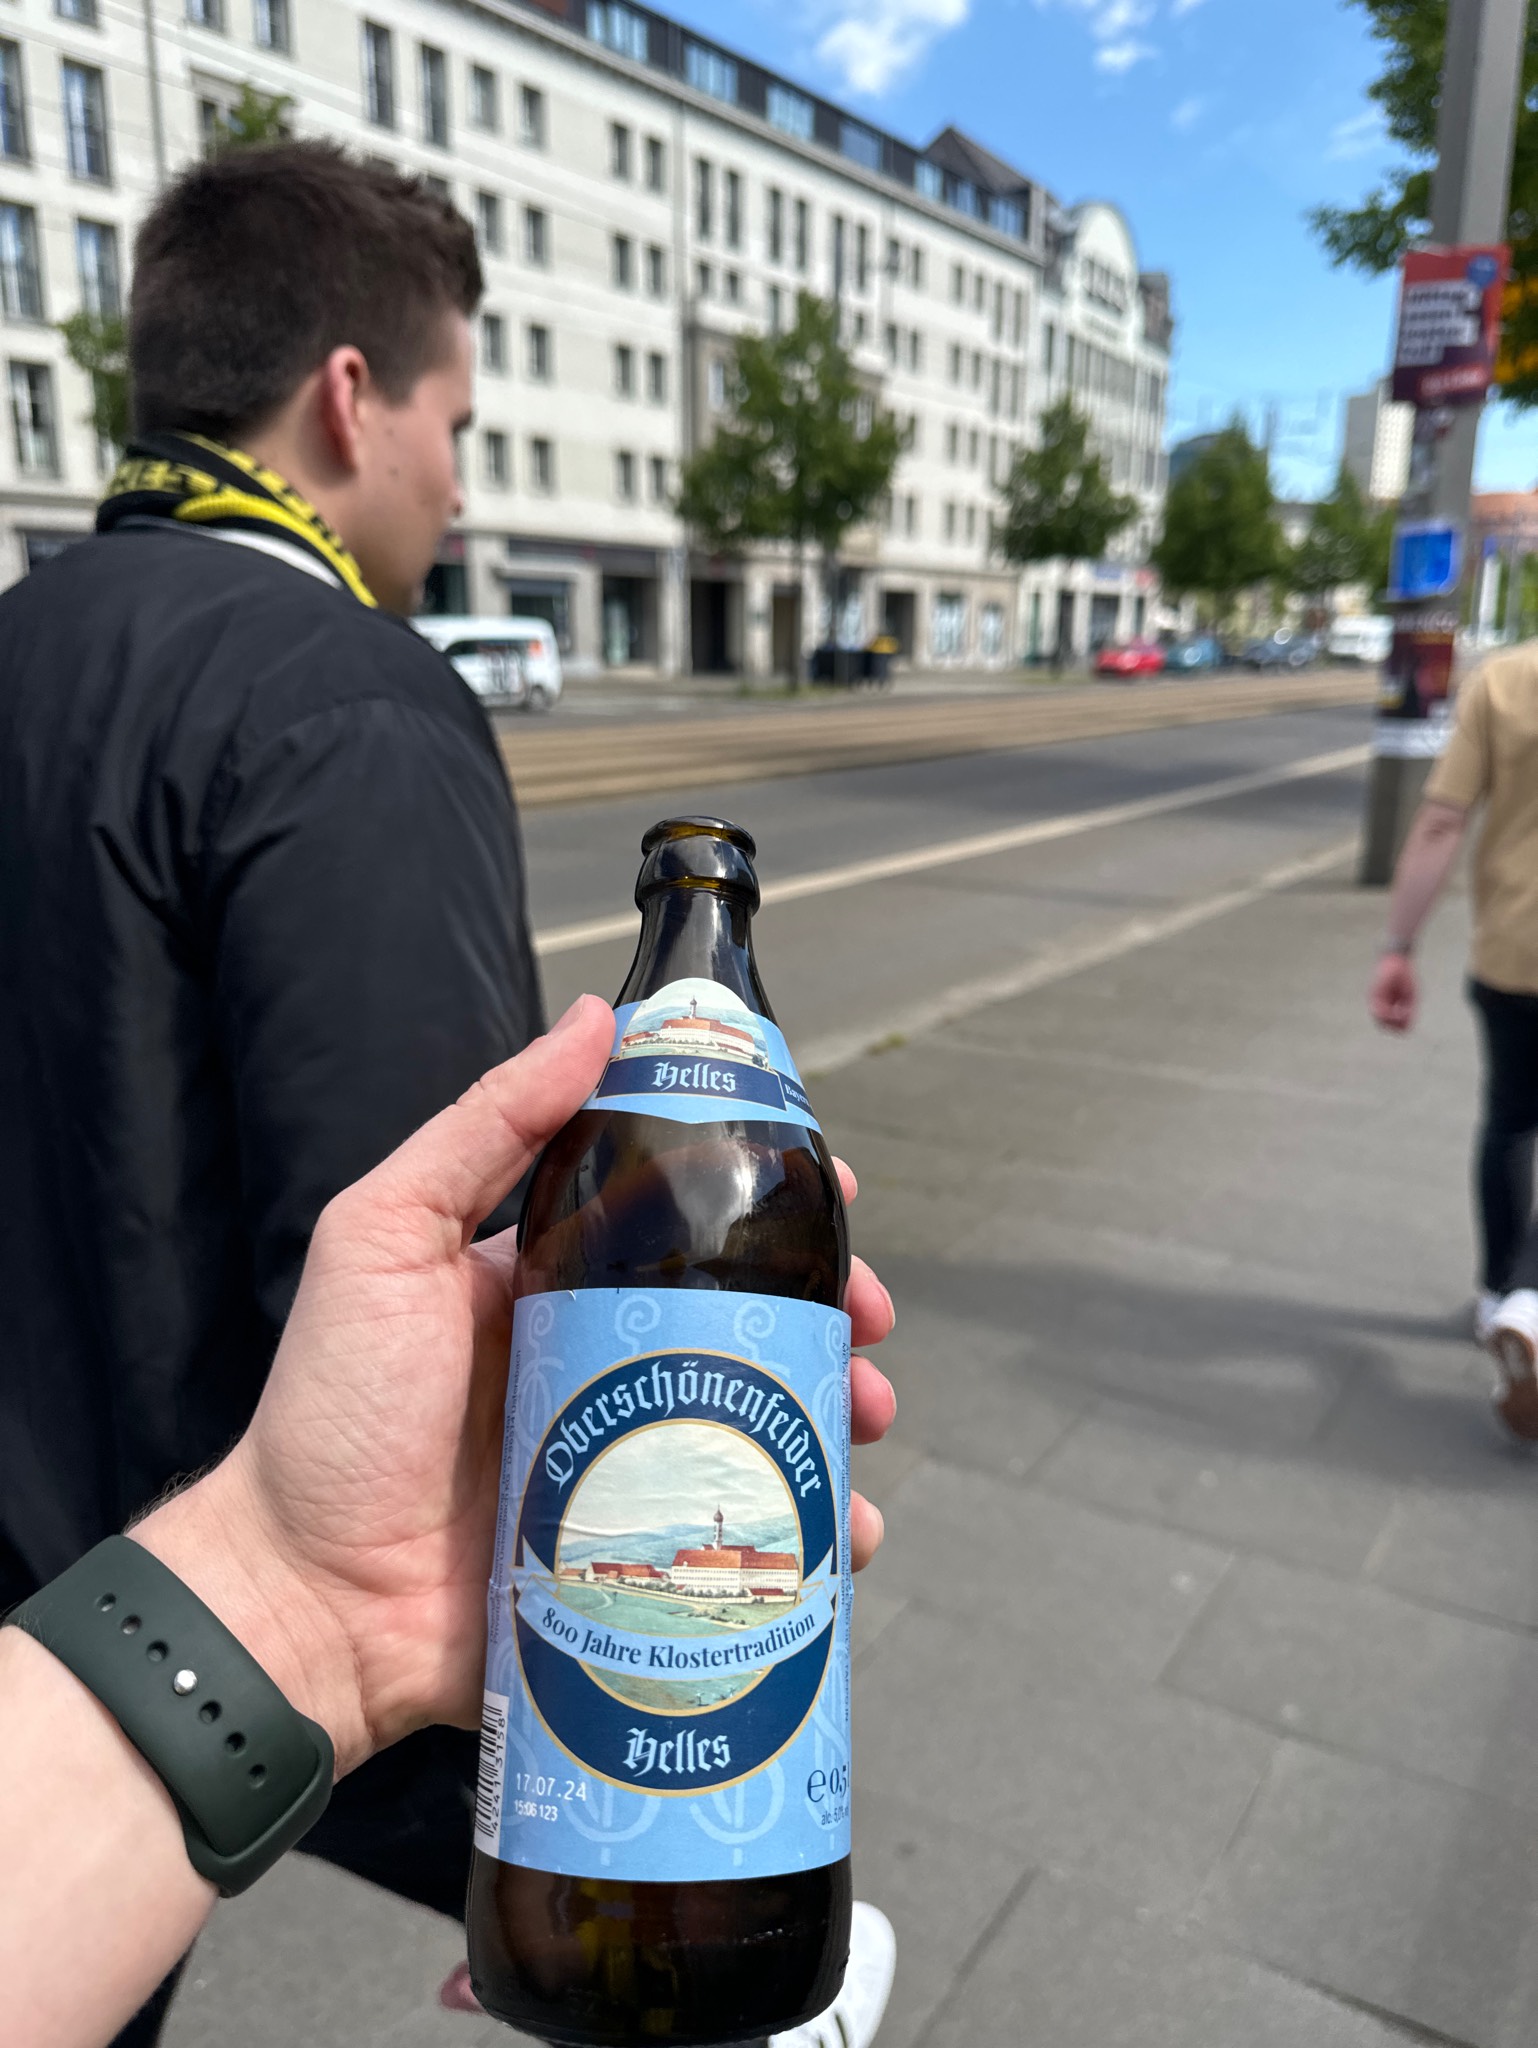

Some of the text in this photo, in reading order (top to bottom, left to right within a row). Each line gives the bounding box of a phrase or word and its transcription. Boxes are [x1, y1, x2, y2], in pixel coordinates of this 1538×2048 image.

[652, 1061, 737, 1093] Helles
[545, 1360, 822, 1498] Oberschönenfelder
[542, 1607, 578, 1643] 800
[579, 1629, 641, 1665] Jahre
[648, 1613, 815, 1669] Klostertradition
[491, 1717, 506, 1831] 4241 3158
[622, 1728, 731, 1777] Helles
[516, 1772, 587, 1802] 17.07.24
[540, 1804, 558, 1821] 123
